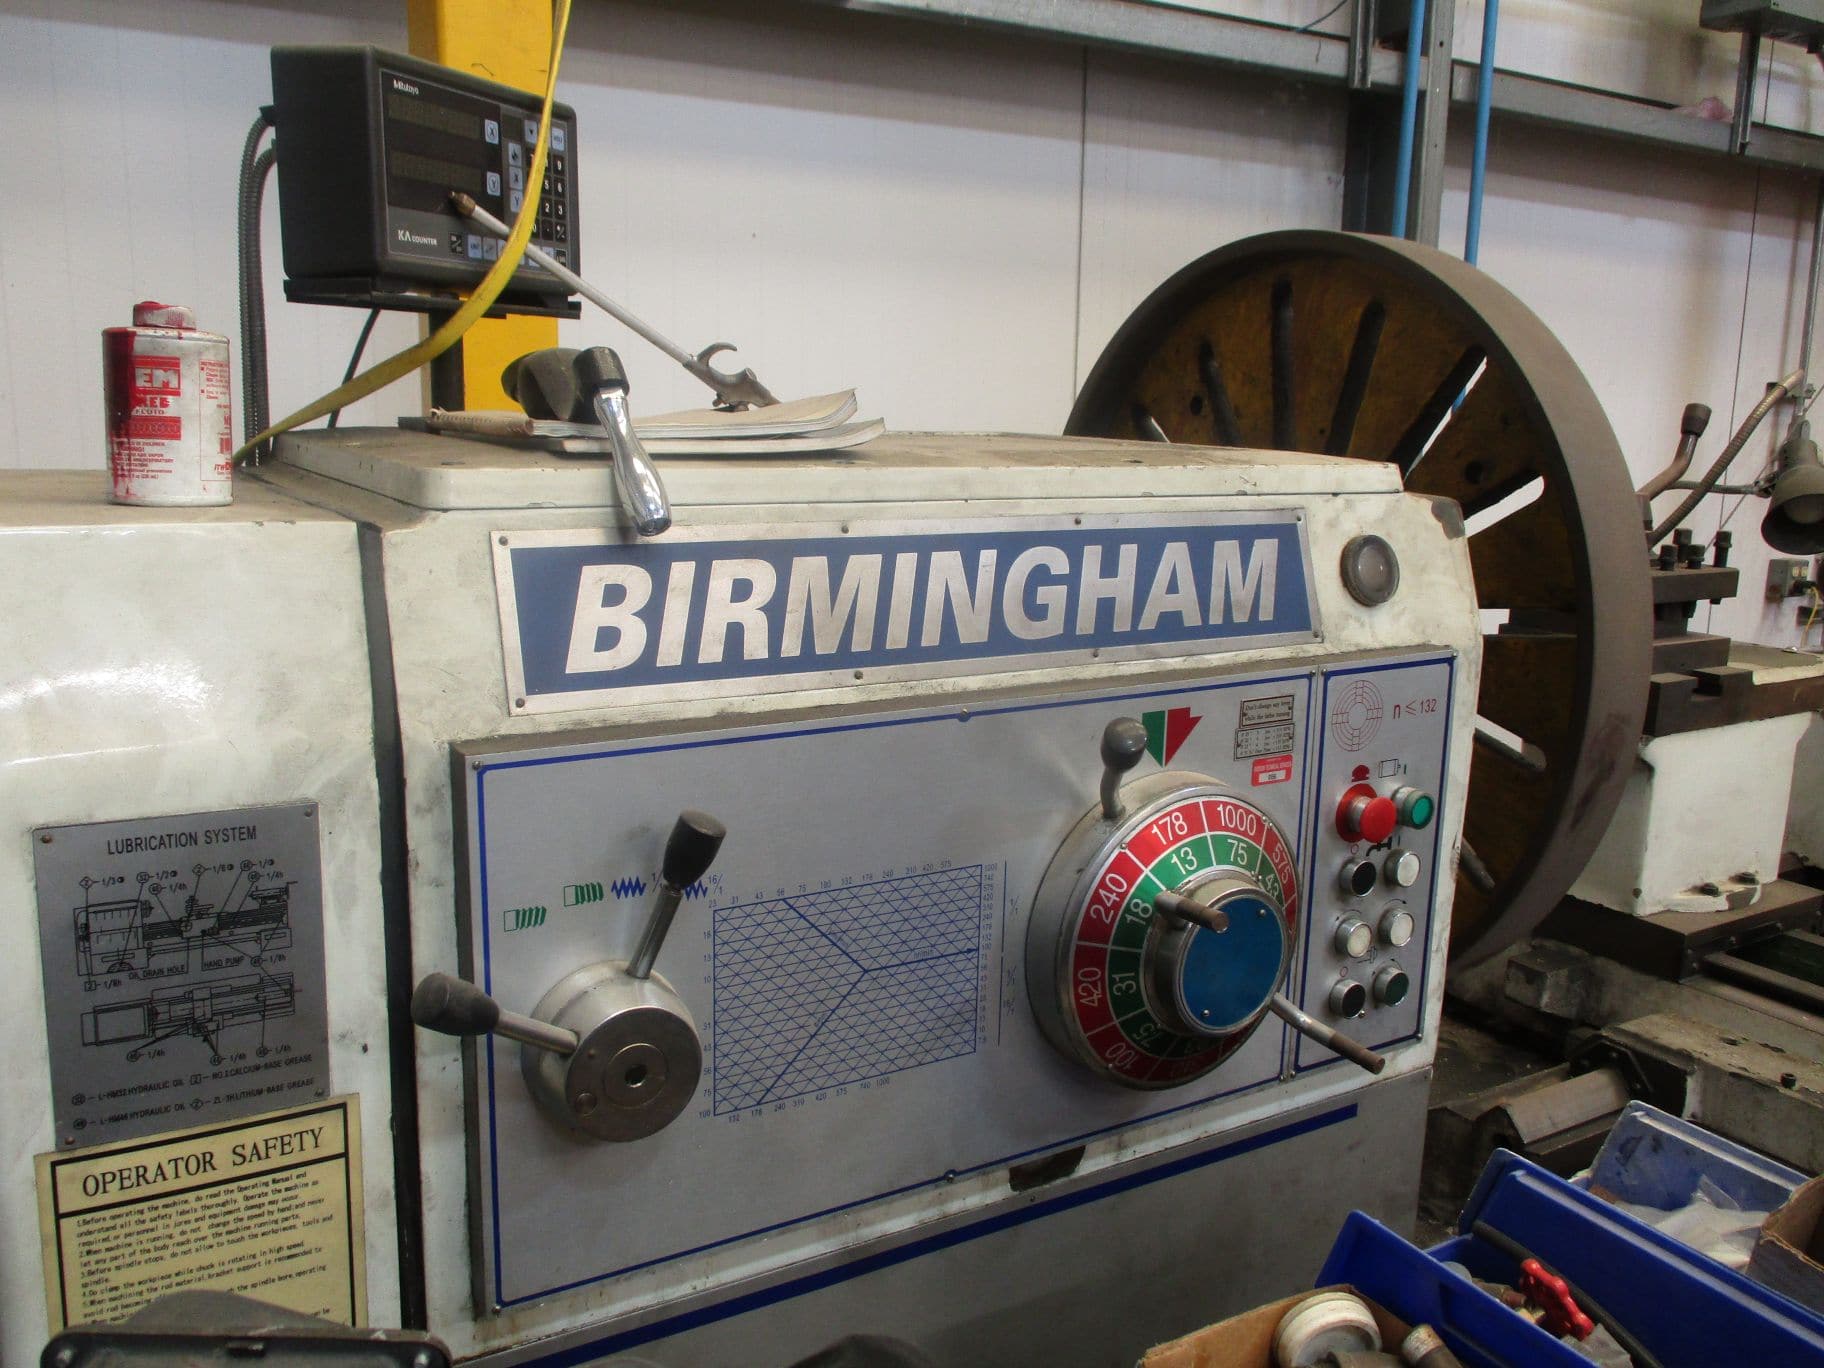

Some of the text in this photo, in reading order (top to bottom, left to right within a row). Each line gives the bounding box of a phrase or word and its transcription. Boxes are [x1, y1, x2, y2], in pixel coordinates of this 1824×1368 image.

[412, 234, 438, 246] COUNTER
[565, 538, 1280, 674] BIRMINGHAM
[1420, 698, 1438, 713] 132
[107, 825, 257, 856] LUBRICATION SYSTEM
[1151, 803, 1292, 885] 178 1000 575
[1171, 847, 1198, 876] 13
[1227, 839, 1248, 866] 75
[1090, 873, 1128, 924] 240
[1125, 898, 1154, 926] 18
[167, 964, 186, 974] HOLE
[204, 956, 245, 968] HAND PUMP
[1079, 966, 1102, 1008] 420
[1112, 970, 1136, 997] 31
[128, 1081, 170, 1095] HYDRAULIC
[285, 1054, 312, 1066] GREASE
[1104, 1042, 1136, 1070] 100
[130, 1105, 172, 1120] HYDRAULIC
[287, 1077, 314, 1090] GREASE
[82, 1127, 325, 1198] OPERATOR SAFETY
[77, 1222, 117, 1237] understand
[119, 1219, 131, 1228] all
[134, 1216, 146, 1224] the
[148, 1211, 171, 1221] safety
[175, 1205, 197, 1215] labels
[242, 1189, 268, 1201] Operate
[270, 1186, 282, 1194] the
[283, 1181, 309, 1191] machine
[108, 1207, 144, 1220] operating
[147, 1203, 159, 1211] the
[205, 1189, 221, 1198] read
[223, 1186, 234, 1194] the
[236, 1180, 269, 1192] Operating
[271, 1173, 292, 1184] Manual
[295, 1170, 306, 1179] and
[104, 1241, 132, 1252] machine
[189, 1223, 201, 1232] not
[207, 1218, 230, 1228] change
[246, 1209, 265, 1220] speed
[266, 1207, 274, 1215] by
[123, 1223, 158, 1238] personnel
[193, 1212, 205, 1221] and
[207, 1204, 240, 1219] equipment
[243, 1200, 265, 1210] damage
[80, 1259, 90, 1267] let
[109, 1251, 124, 1262] part
[128, 1248, 136, 1256] of
[139, 1246, 151, 1254] the
[153, 1242, 169, 1251] body
[172, 1236, 191, 1246] reach
[193, 1234, 207, 1242] over
[211, 1229, 222, 1237] the
[225, 1224, 251, 1234] machine
[253, 1217, 278, 1228] running
[114, 1258, 141, 1270] spindle
[180, 1246, 191, 1254] not
[226, 1233, 245, 1244] touch
[247, 1231, 258, 1239] the
[302, 1217, 319, 1226] tools
[321, 1213, 333, 1222] and
[108, 1288, 143, 1300] machining
[146, 1284, 157, 1292] the
[160, 1279, 173, 1288] rod
[236, 1258, 261, 1271] support
[122, 1279, 135, 1288] the
[137, 1272, 171, 1284] workpiece
[174, 1266, 193, 1276] while
[196, 1260, 214, 1271] chuck
[227, 1252, 256, 1263] rotating
[268, 1244, 283, 1254] high
[237, 1283, 247, 1291] the
[250, 1276, 275, 1288] spindle
[106, 1303, 118, 1312] rod
